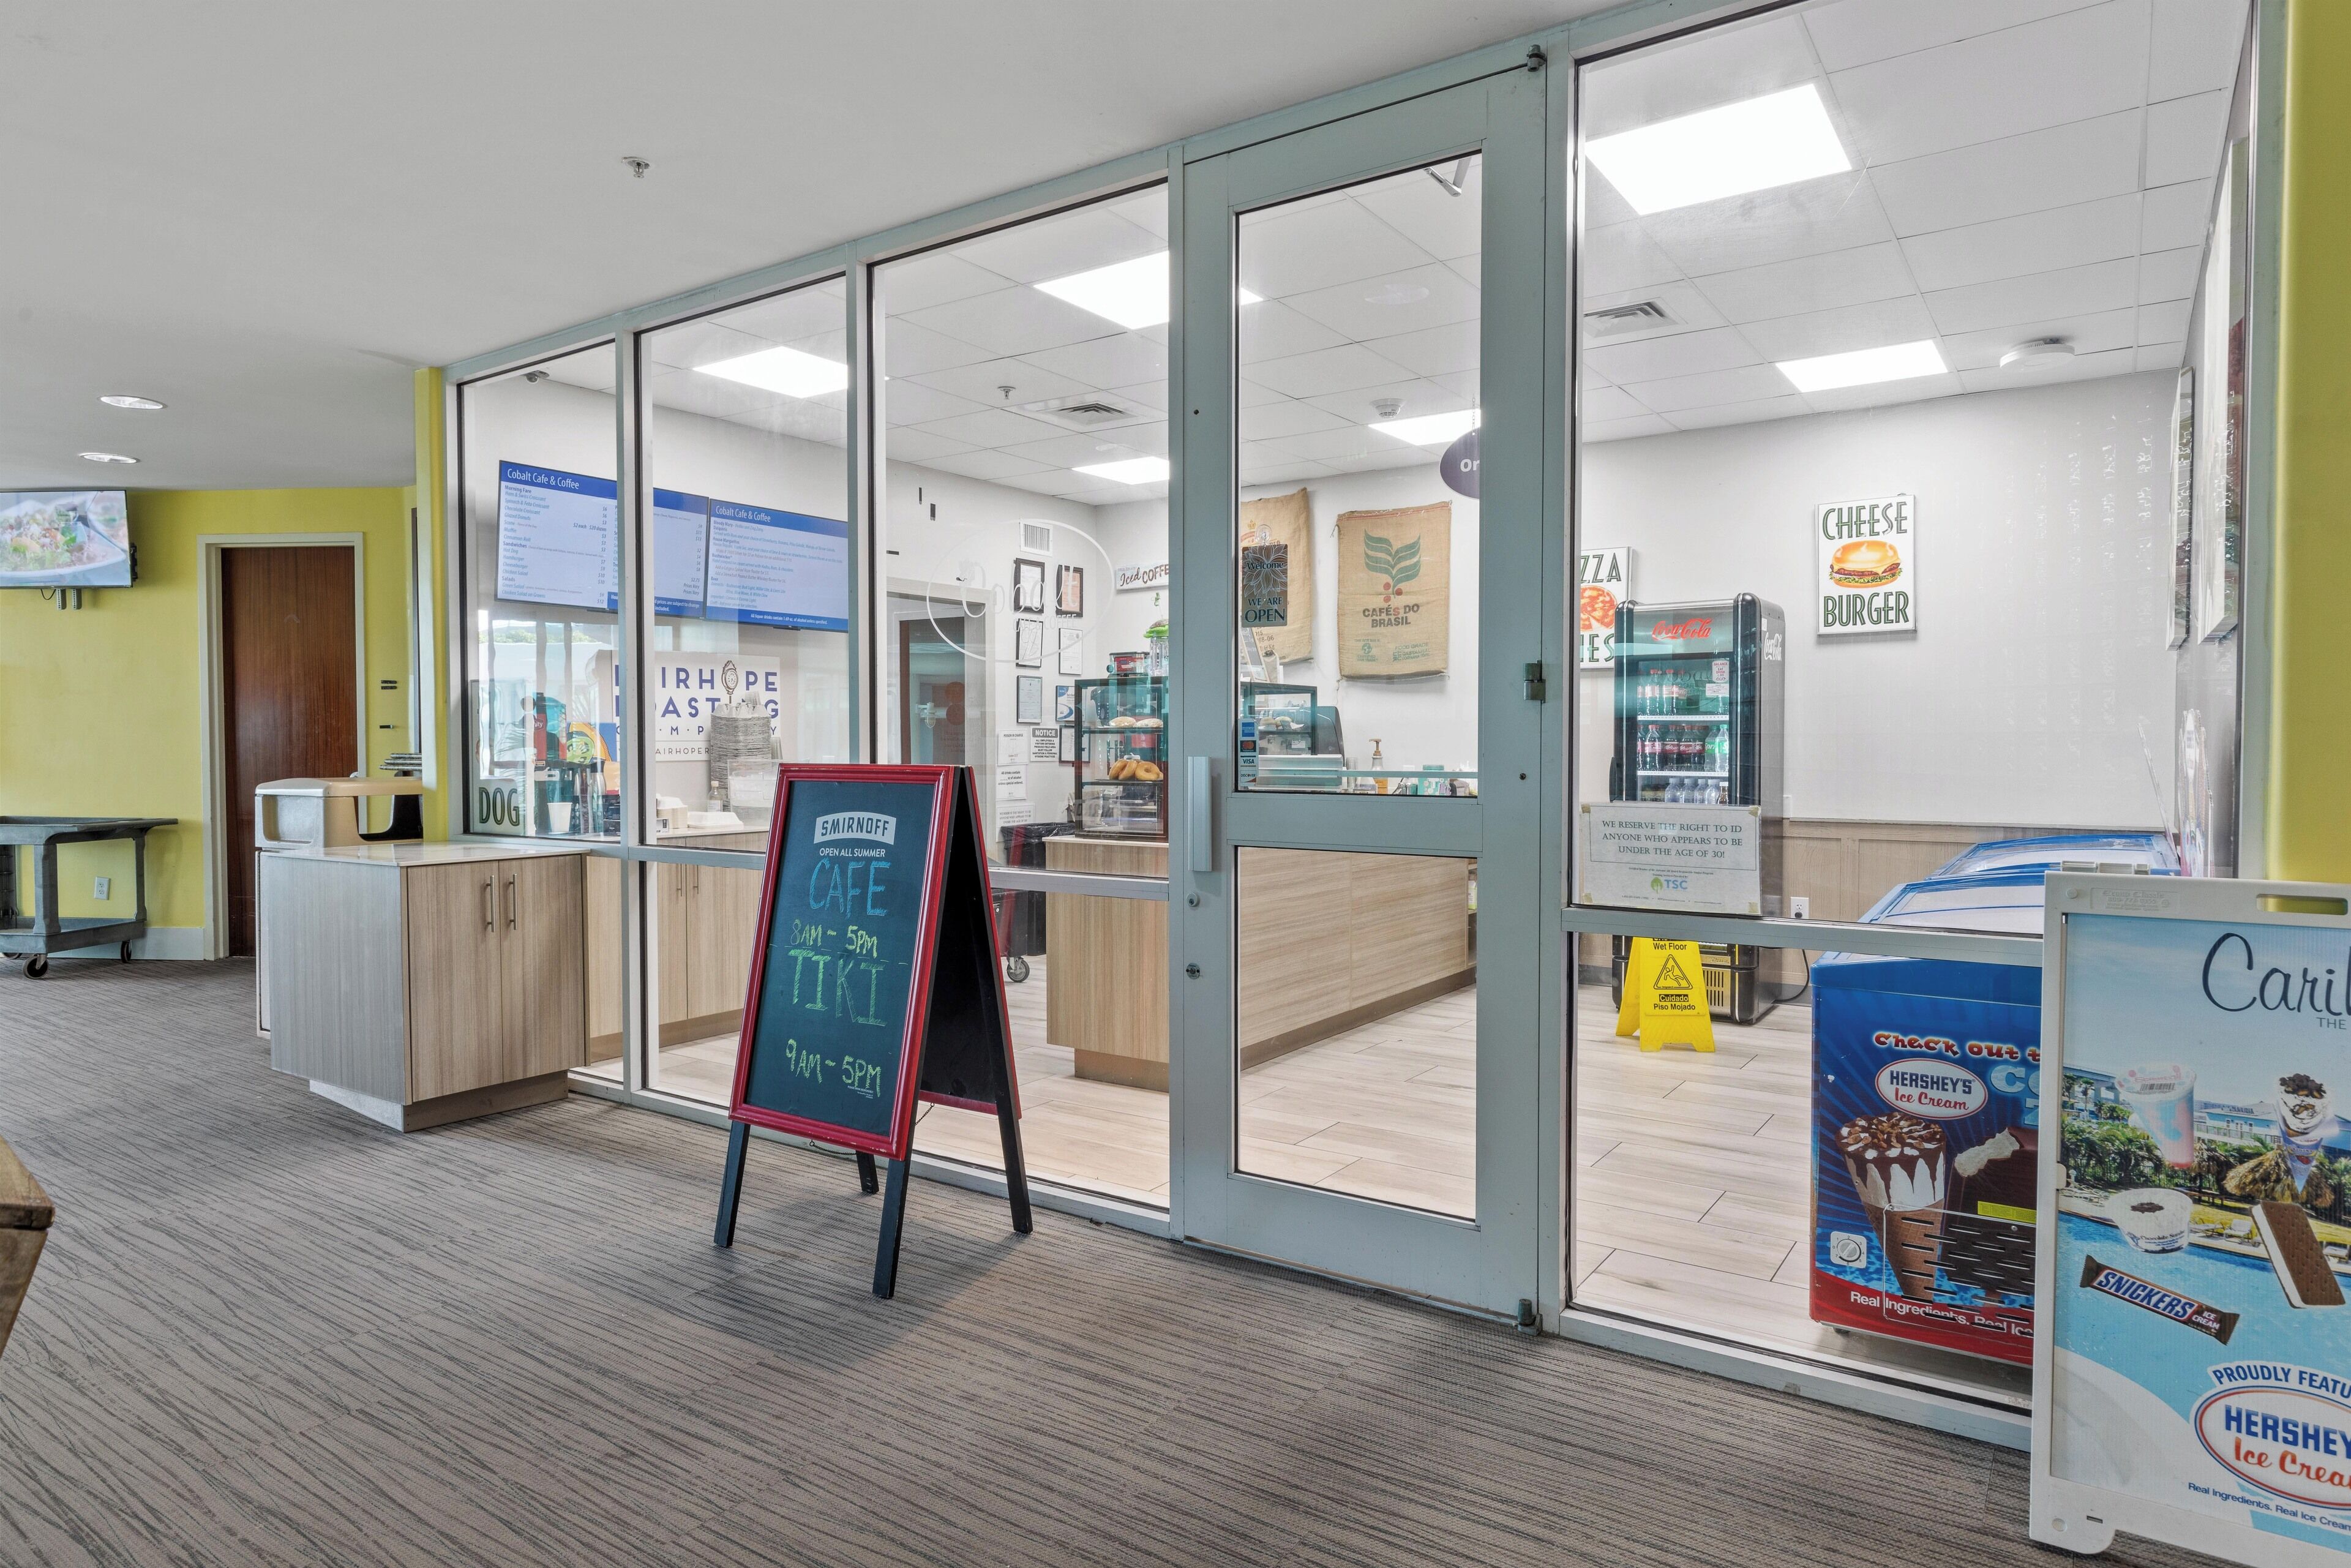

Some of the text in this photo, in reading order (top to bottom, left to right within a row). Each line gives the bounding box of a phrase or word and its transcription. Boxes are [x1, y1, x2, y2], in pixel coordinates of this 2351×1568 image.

[507, 468, 579, 490] Cobalt Cafe & Coffee
[716, 505, 733, 516] Cobalt
[735, 509, 747, 519] Cafe
[754, 512, 771, 523] Coffee
[1822, 501, 1907, 540] CHEESE
[1247, 561, 1284, 570] Welcome
[1120, 567, 1141, 587] Iced
[1248, 598, 1262, 606] WE
[1363, 603, 1420, 617] CAFÉS DO
[1824, 591, 1909, 628] BURGER
[1044, 613, 1078, 631] COFFEE
[1245, 609, 1285, 623] OPEN
[1371, 616, 1411, 628] BRASIL
[1652, 617, 1713, 641] Coca-Cola
[479, 786, 520, 827] DOG
[821, 816, 889, 837] SMIRNOFF
[1619, 821, 1655, 829] RESERVE
[1680, 823, 1710, 832] RIGHT
[1602, 833, 1641, 842] ANYONE
[1671, 836, 1711, 844] APPEARS
[819, 848, 885, 857] OPEN ALL SUMMER
[1619, 846, 1650, 854] UNDER
[809, 857, 891, 919] CAFE
[1664, 880, 1688, 890] TSC
[790, 919, 822, 947] 8AM
[846, 925, 878, 959] 5PM
[788, 949, 887, 1026] TIKI
[2316, 1017, 2347, 1030] THE
[1968, 1043, 2019, 1060] out
[786, 1038, 823, 1084] 9AM
[842, 1055, 882, 1097] 5PM
[1890, 1070, 1972, 1095] HERSHEY'S
[1895, 1087, 1969, 1111] Ice Cream
[1850, 1291, 1880, 1308] Real
[2097, 1270, 2195, 1320] SNICKERS
[2192, 1315, 2220, 1330] CREAM
[2203, 1311, 2216, 1320] ICE
[2213, 1364, 2291, 1385] PROUDLY
[2234, 1436, 2273, 1468] Ice
[2188, 1482, 2210, 1495] Real
[2212, 1488, 2272, 1511] Ingredients.
[2276, 1505, 2298, 1518] Real
[2301, 1510, 2316, 1522] Ice
